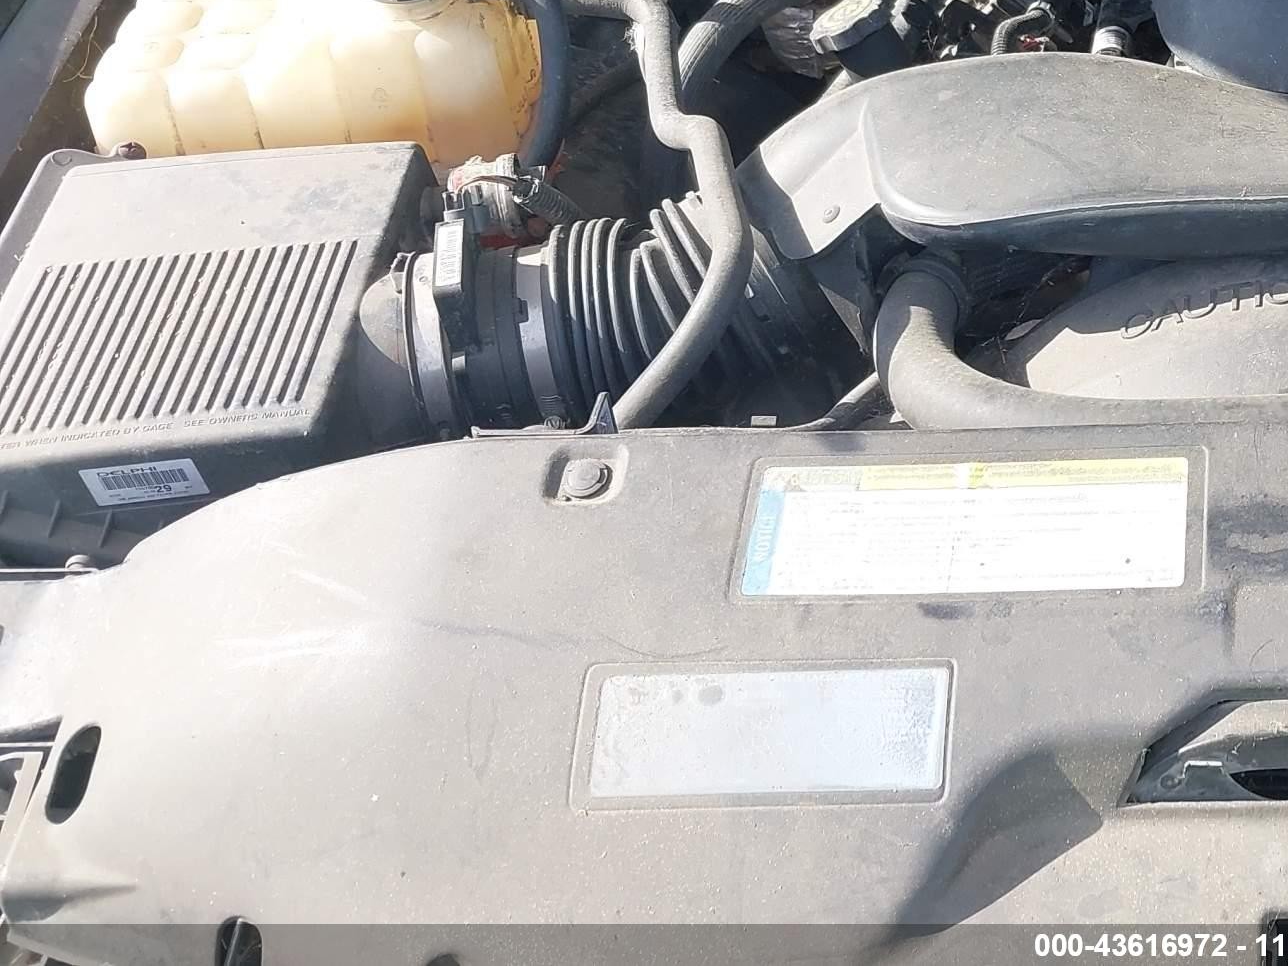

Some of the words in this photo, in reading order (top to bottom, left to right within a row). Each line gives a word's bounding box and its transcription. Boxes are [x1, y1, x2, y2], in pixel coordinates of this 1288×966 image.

[60, 428, 121, 442] INDICATED
[184, 419, 205, 428] SEE
[261, 409, 311, 419] MANUAL
[96, 466, 158, 477] DELPHI
[154, 484, 172, 493] 29
